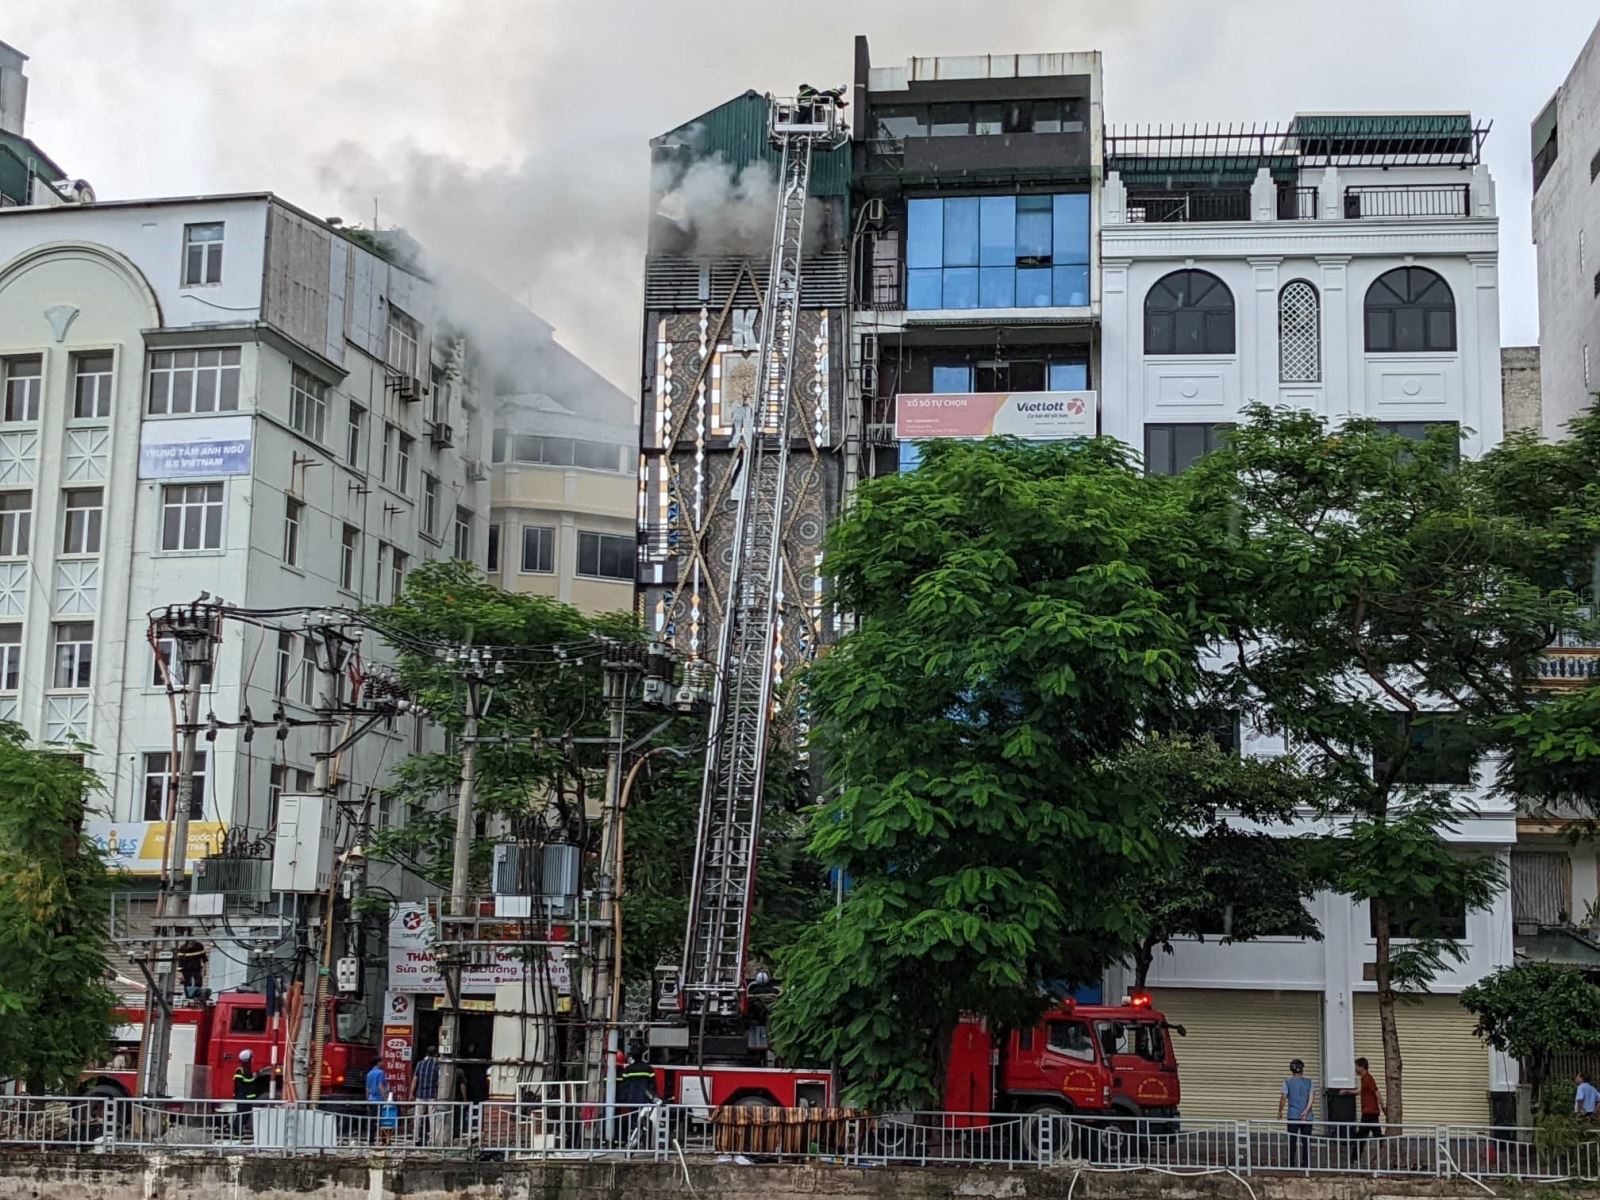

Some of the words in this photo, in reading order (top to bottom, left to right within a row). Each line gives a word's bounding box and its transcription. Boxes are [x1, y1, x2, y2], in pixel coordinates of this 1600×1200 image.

[1016, 401, 1065, 412] Vietlott
[200, 446, 222, 456] ANH
[395, 963, 417, 974] Sửa
